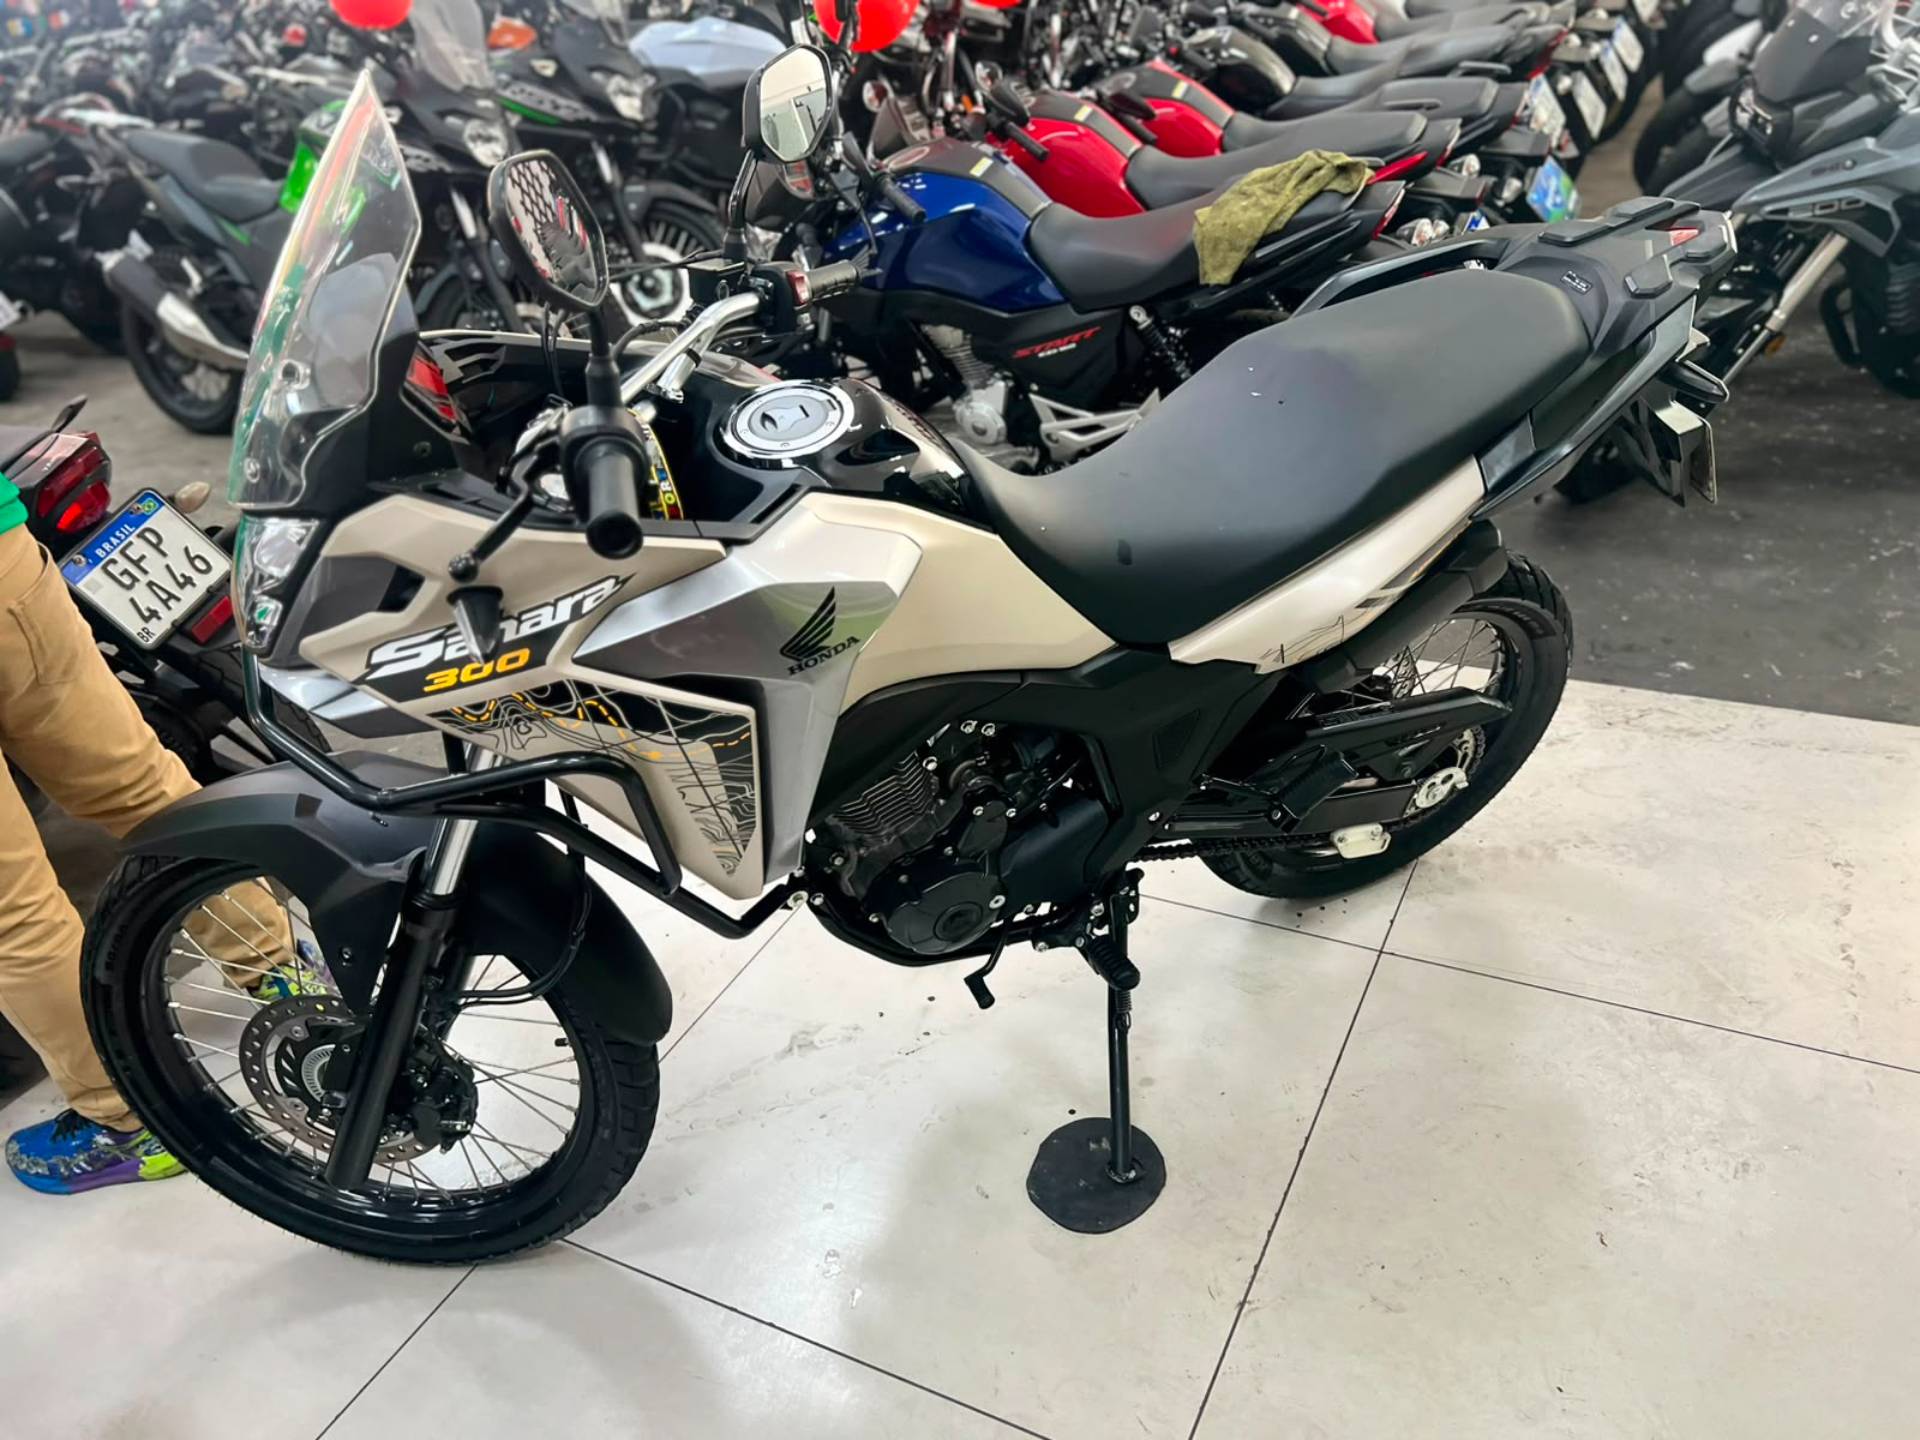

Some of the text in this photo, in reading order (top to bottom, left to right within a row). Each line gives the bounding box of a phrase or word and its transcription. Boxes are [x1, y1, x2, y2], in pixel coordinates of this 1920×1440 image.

[94, 523, 137, 560] BRASIL
[100, 526, 169, 591] GFP
[129, 545, 213, 624] 4A46
[136, 626, 157, 644] BR
[787, 635, 860, 676] HONDA
[423, 646, 531, 693] 300
